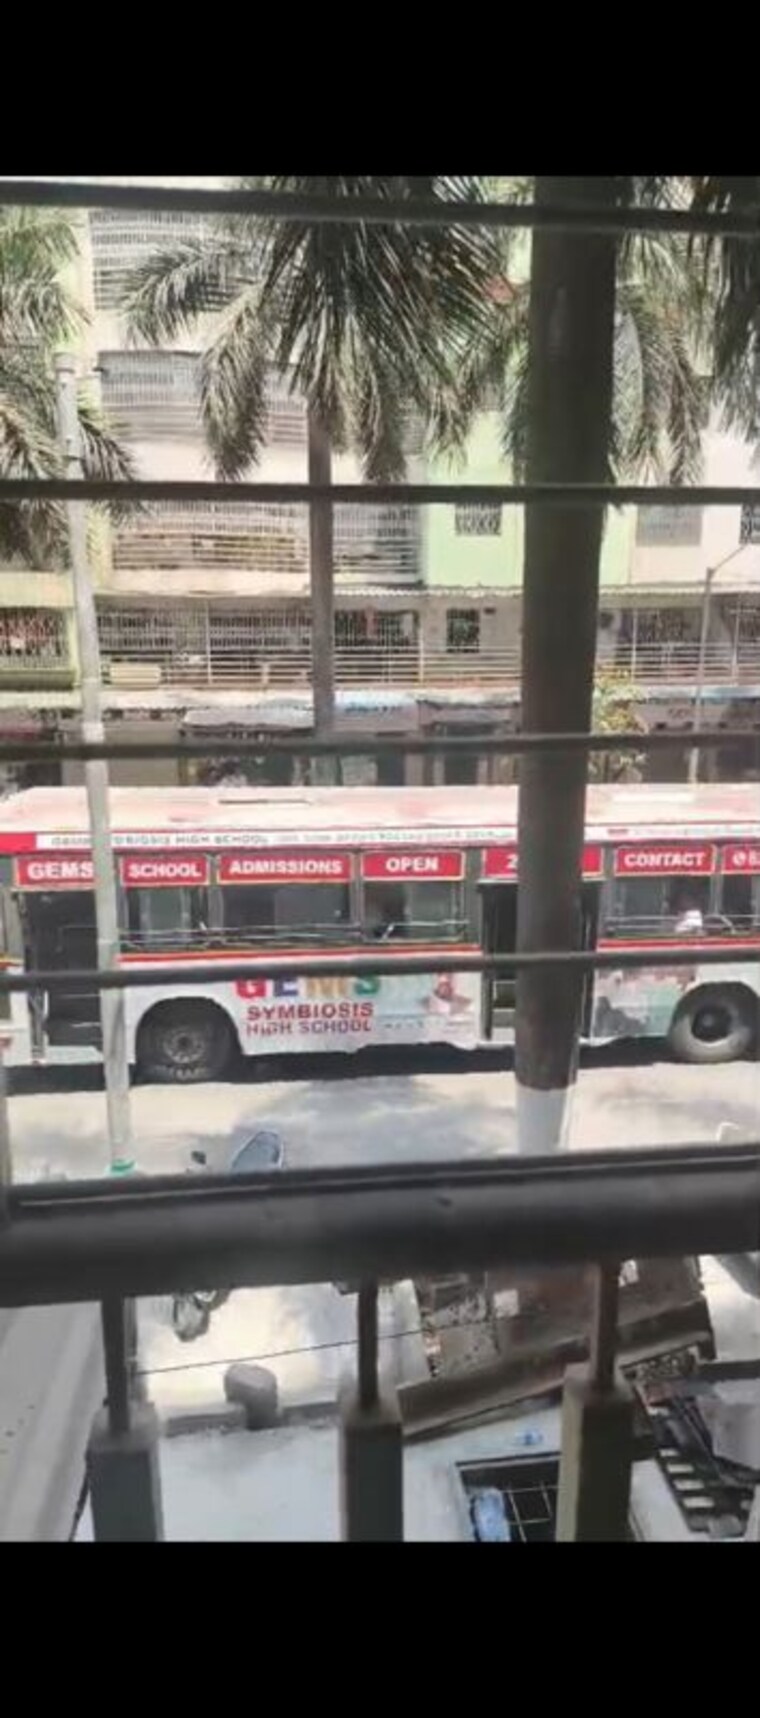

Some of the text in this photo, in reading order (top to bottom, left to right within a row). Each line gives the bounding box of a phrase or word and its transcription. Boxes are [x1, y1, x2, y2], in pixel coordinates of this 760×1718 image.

[27, 861, 94, 880] GEMS
[129, 862, 202, 878] SCHOOL
[229, 858, 343, 876] ADMISSIONS
[385, 856, 439, 872] OPEN
[624, 852, 705, 867] CONTACT
[247, 1003, 374, 1020] SYMBIOSIS
[247, 1022, 291, 1036] HIGH
[299, 1019, 372, 1034] SCHOOL
